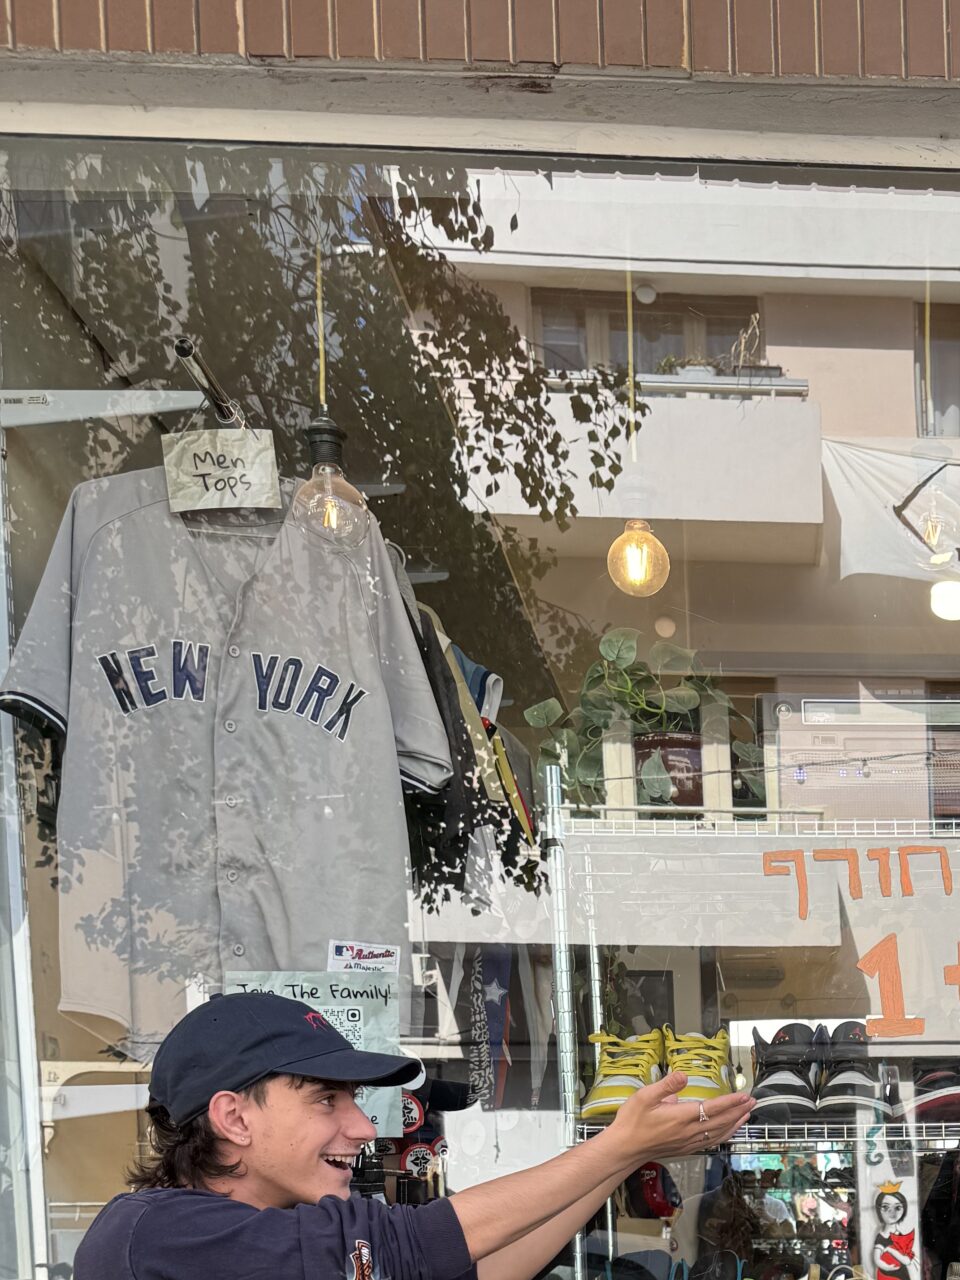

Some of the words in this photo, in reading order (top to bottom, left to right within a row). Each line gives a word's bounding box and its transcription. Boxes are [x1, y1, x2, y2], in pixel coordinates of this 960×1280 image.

[192, 449, 246, 470] Men
[193, 472, 251, 498] Tops
[96, 639, 211, 717] NEW
[251, 652, 370, 743] YORK
[352, 949, 395, 960] Authentic
[354, 962, 383, 972] Majestic
[284, 983, 320, 1000] The
[329, 983, 391, 1007] Family!
